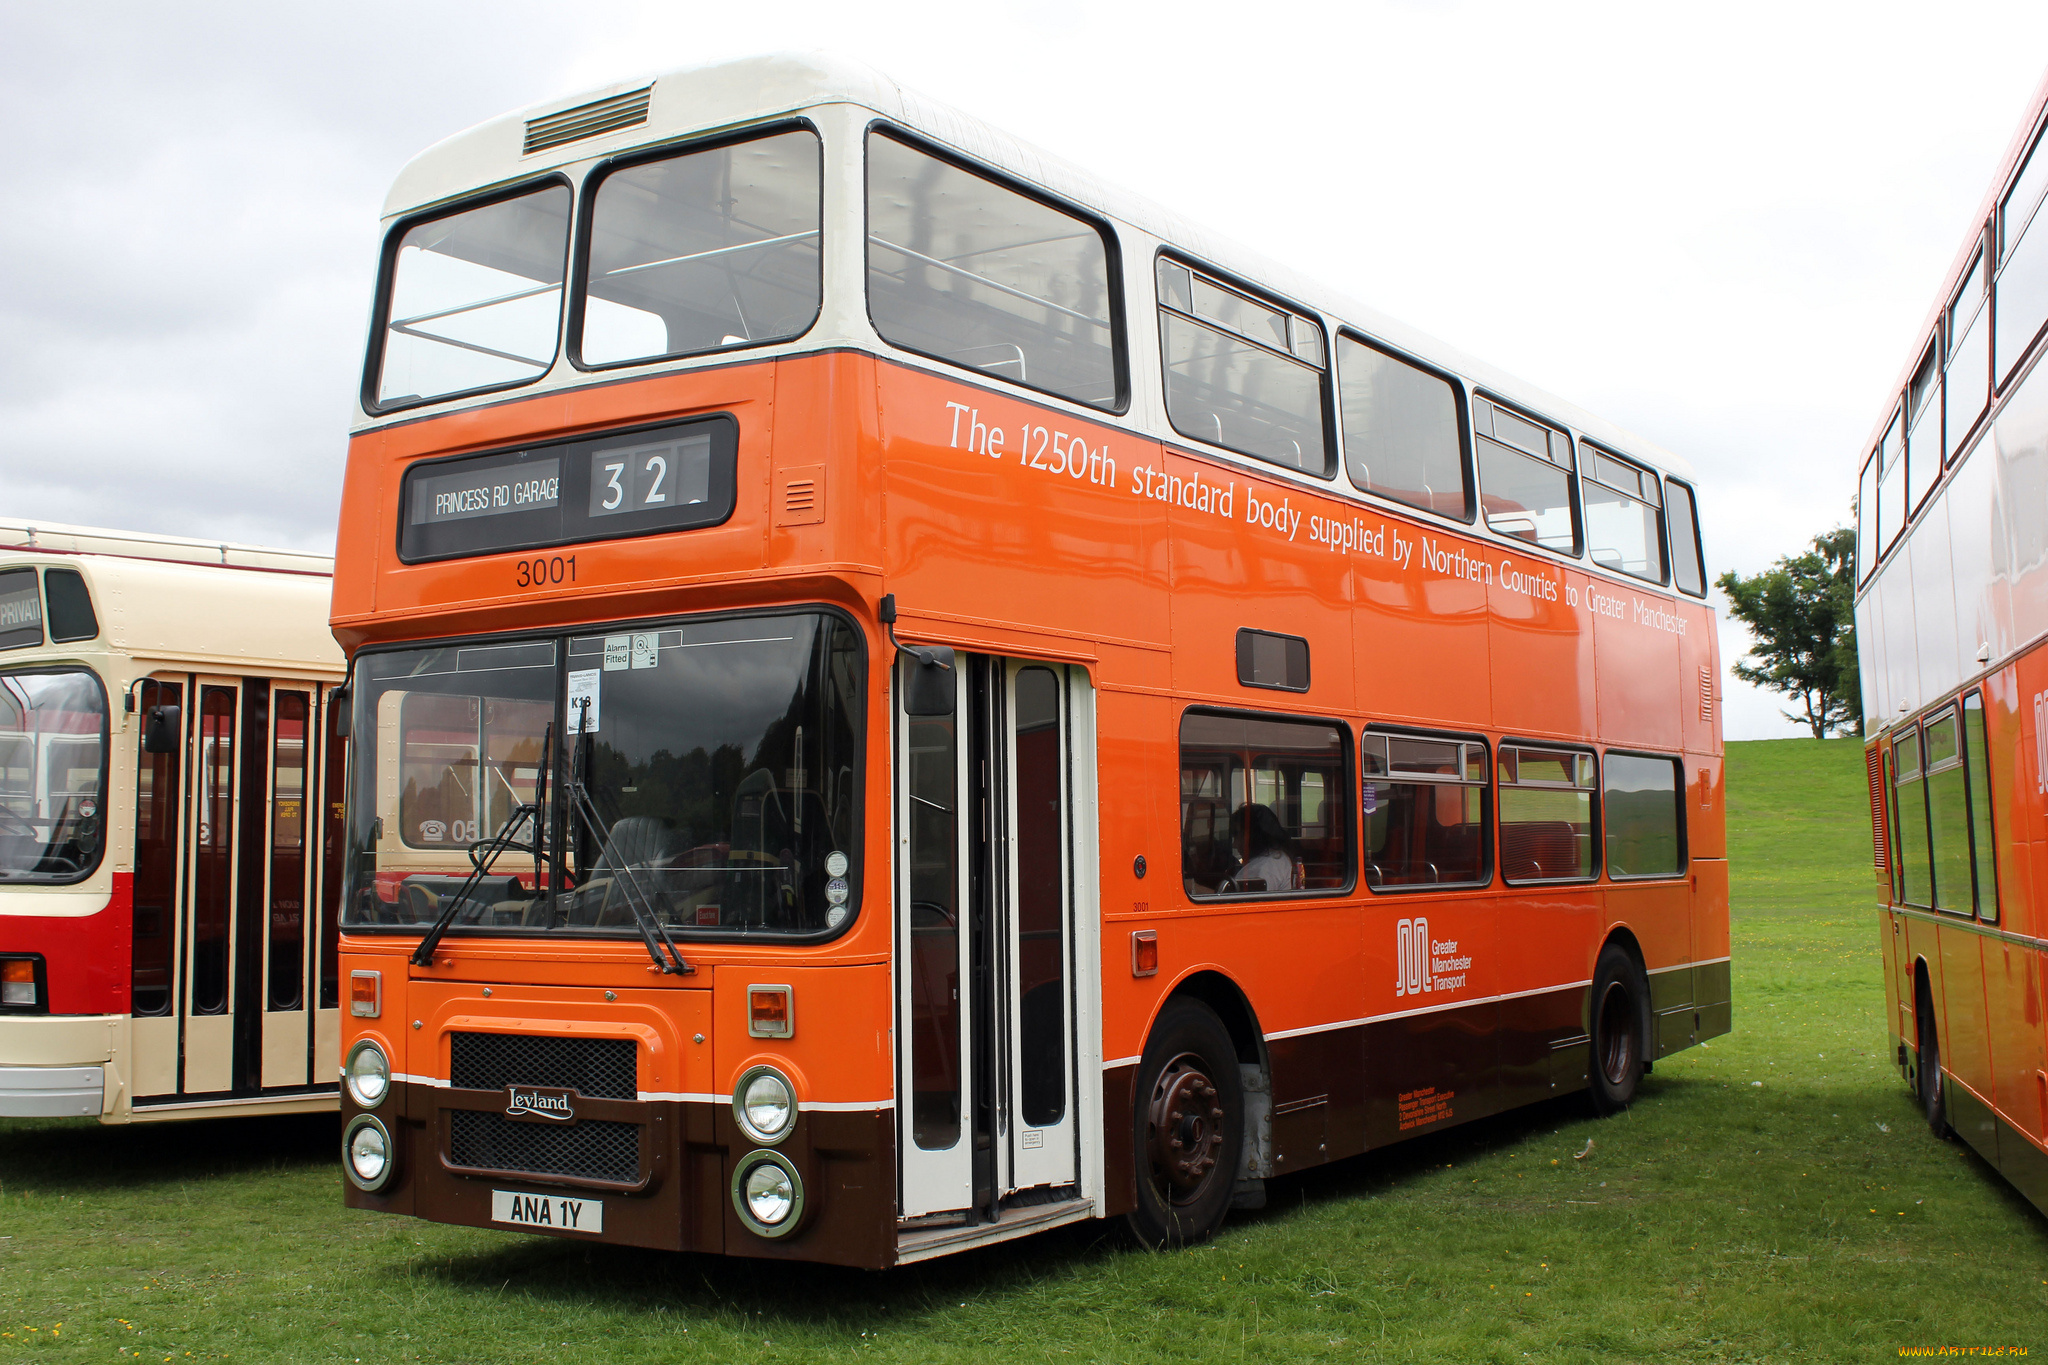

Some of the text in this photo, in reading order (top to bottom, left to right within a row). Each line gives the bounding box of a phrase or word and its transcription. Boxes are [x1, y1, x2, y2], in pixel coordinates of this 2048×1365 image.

[436, 487, 489, 515] PRINCESS
[493, 485, 509, 507] RD
[946, 401, 1688, 636] The 1250th standard body supplied by Northern Counties to Greater Manchester
[516, 555, 577, 587] 3001
[606, 644, 628, 652] Alarm
[605, 654, 627, 664] Fitted
[1133, 902, 1149, 912] 3001
[1432, 939, 1458, 955] Greater
[1432, 955, 1472, 973] Manchester
[1433, 973, 1466, 992] Transport
[506, 1088, 573, 1119] Leyland
[511, 1196, 582, 1228] ANA 1Y
